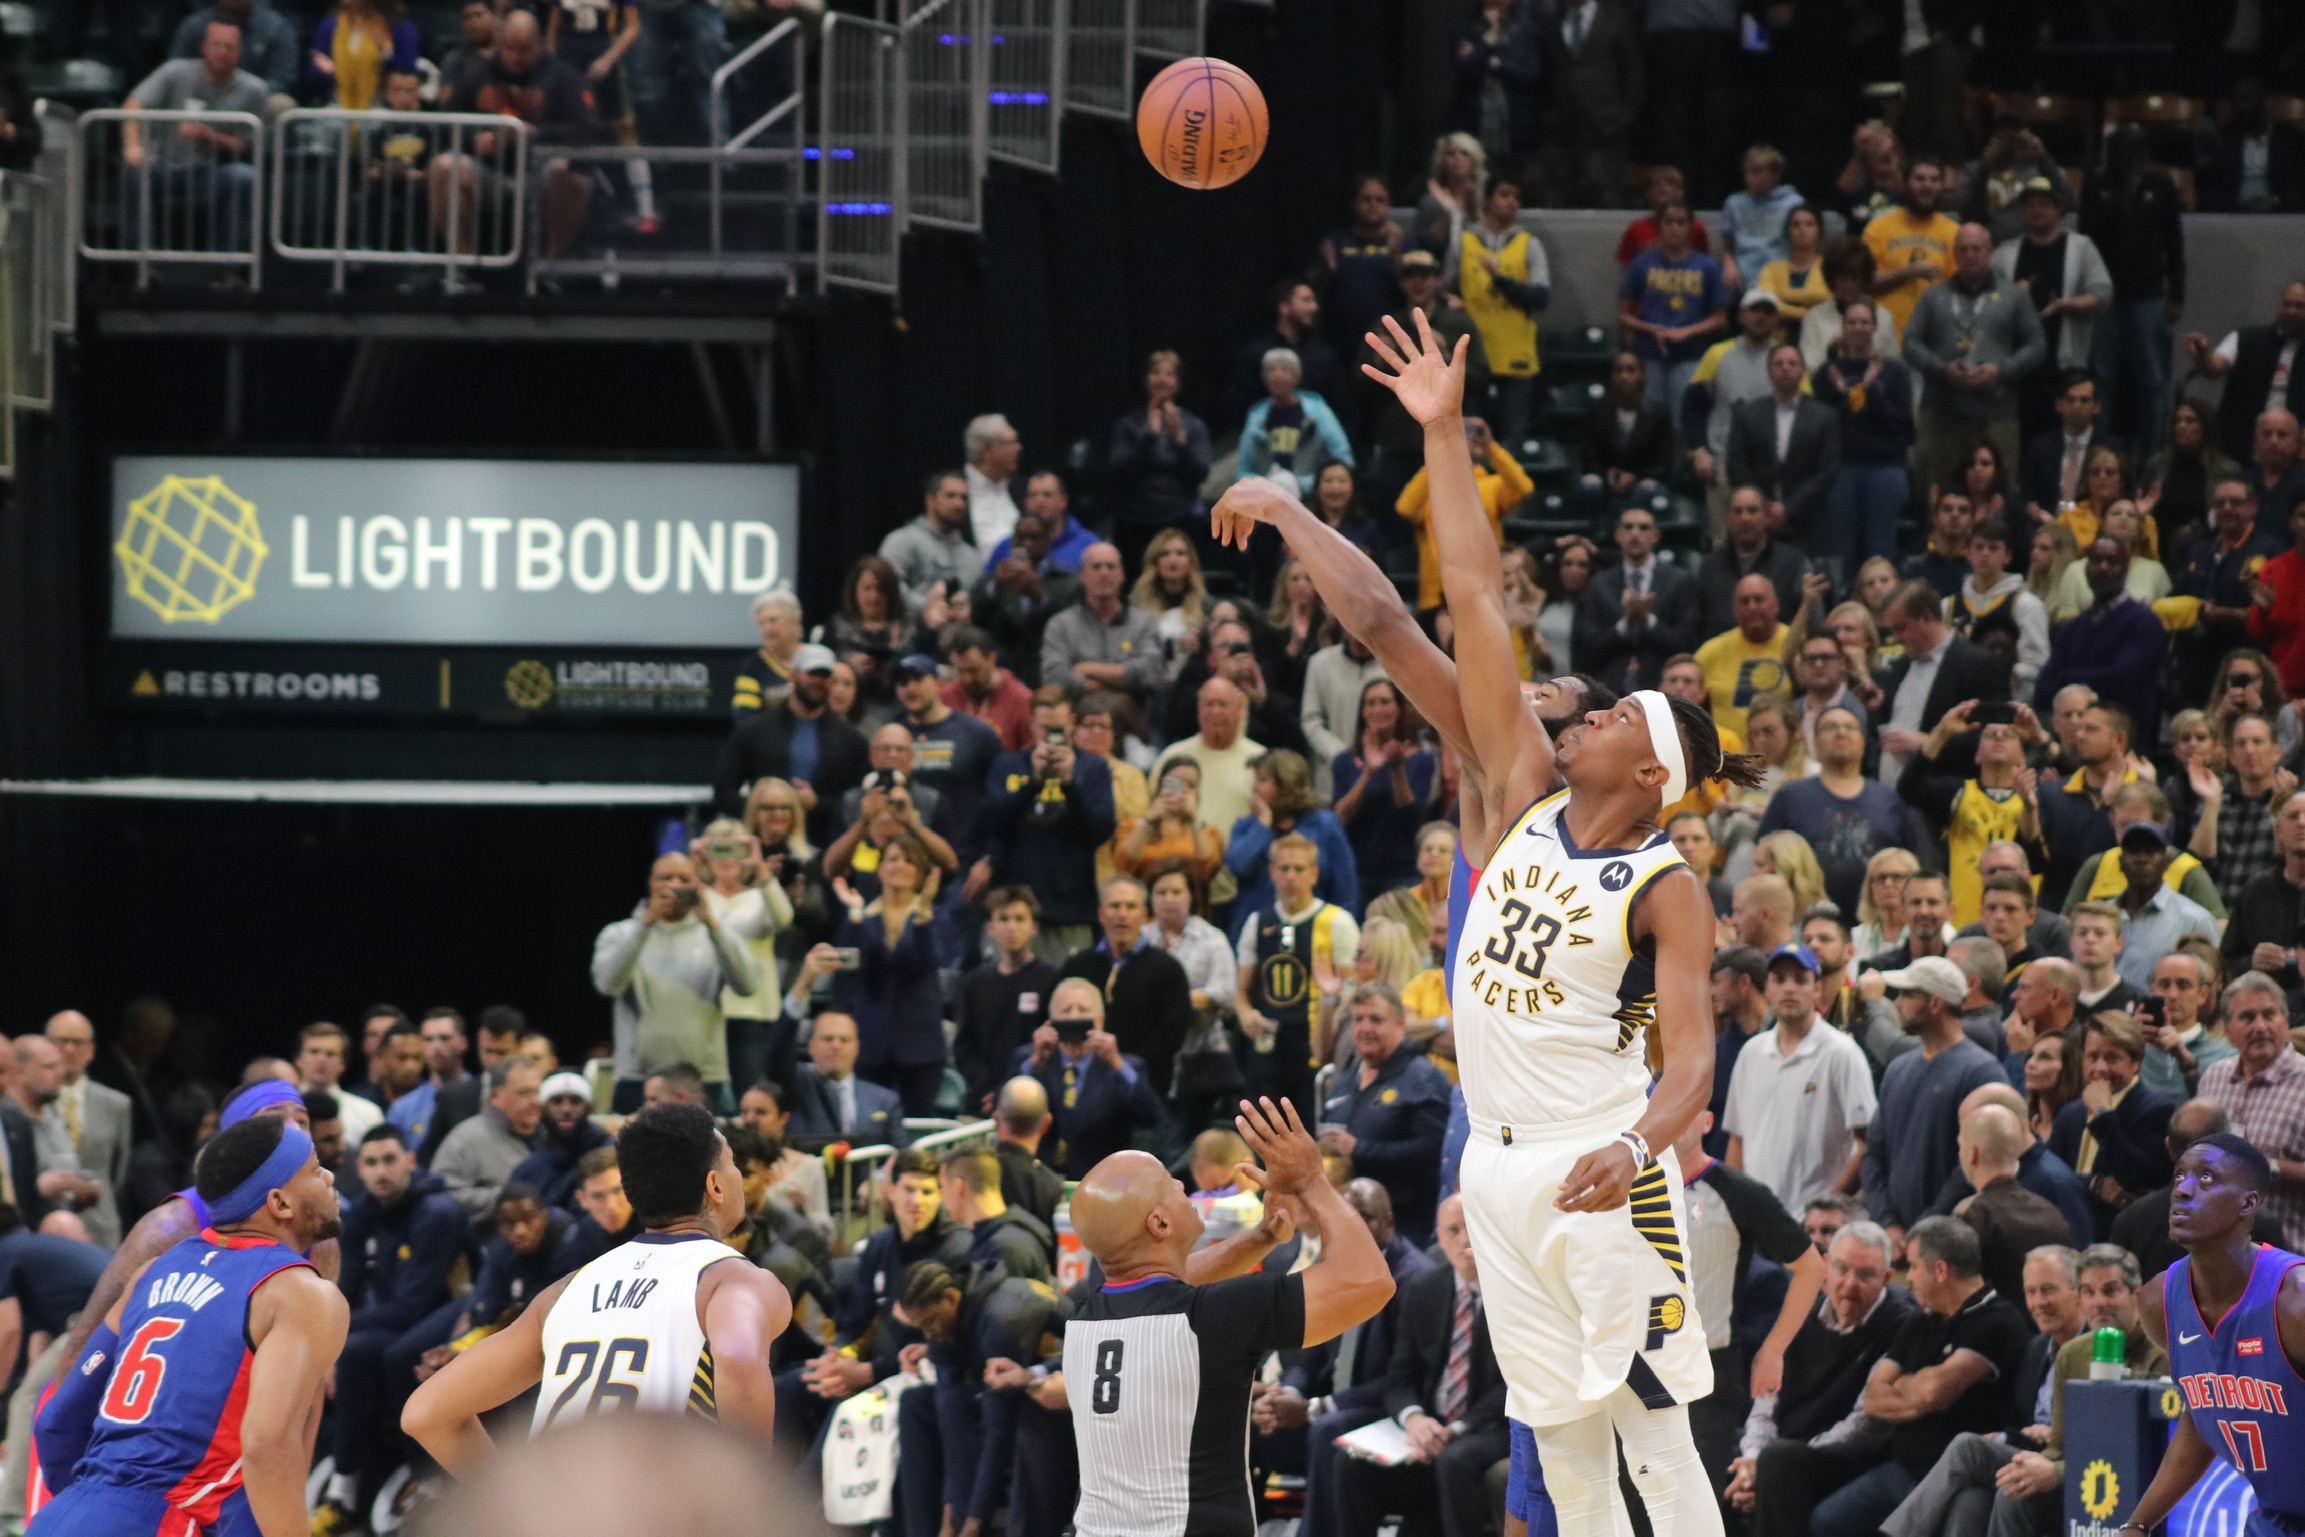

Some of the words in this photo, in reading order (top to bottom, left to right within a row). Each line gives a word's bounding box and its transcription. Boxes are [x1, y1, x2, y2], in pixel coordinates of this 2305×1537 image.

[1182, 109, 1206, 180] ALDING
[291, 514, 780, 595] LIGHTBOUND
[163, 670, 381, 700] RESTROOMS
[556, 660, 710, 688] LIGHTBOUND
[1484, 898, 1562, 979] 33
[1486, 865, 1595, 948] INDIANA
[1466, 949, 1565, 1014] PACERS
[148, 1272, 225, 1312] BROWN
[591, 1278, 659, 1313] LAMB
[100, 1316, 186, 1424] 6
[546, 1336, 650, 1420] 26
[1092, 1339, 1125, 1414] 8
[2179, 1372, 2289, 1416] DETROIT
[2217, 1419, 2268, 1472] 17
